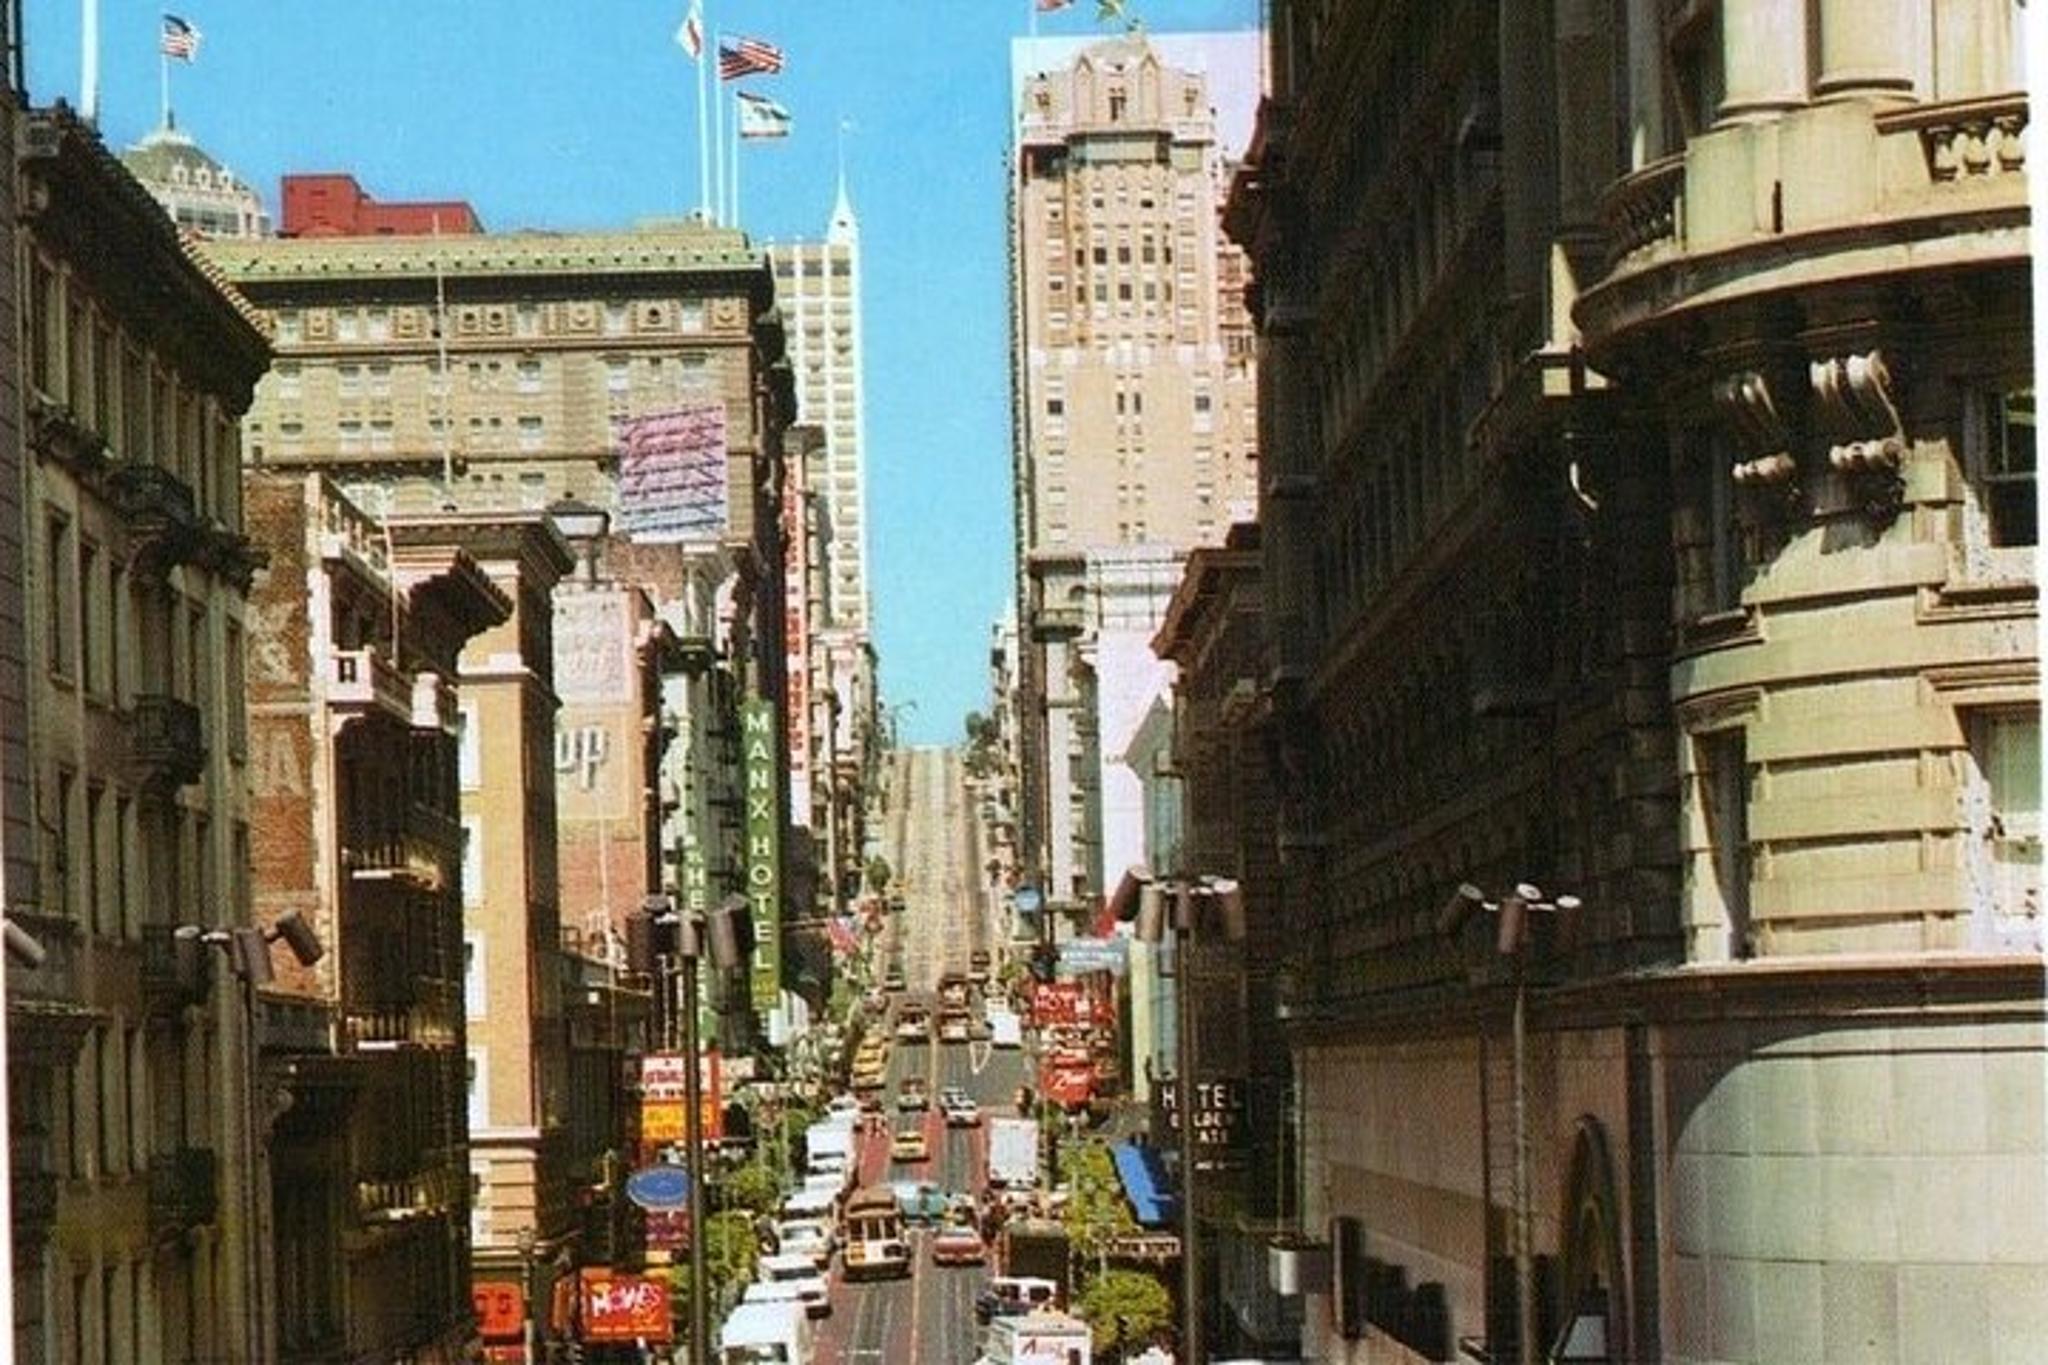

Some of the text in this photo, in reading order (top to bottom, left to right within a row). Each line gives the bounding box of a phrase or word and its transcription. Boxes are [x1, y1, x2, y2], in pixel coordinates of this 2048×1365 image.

[746, 713, 769, 819] MANX
[752, 838, 773, 970] HOTEL
[1162, 1083, 1242, 1108] HTEL
